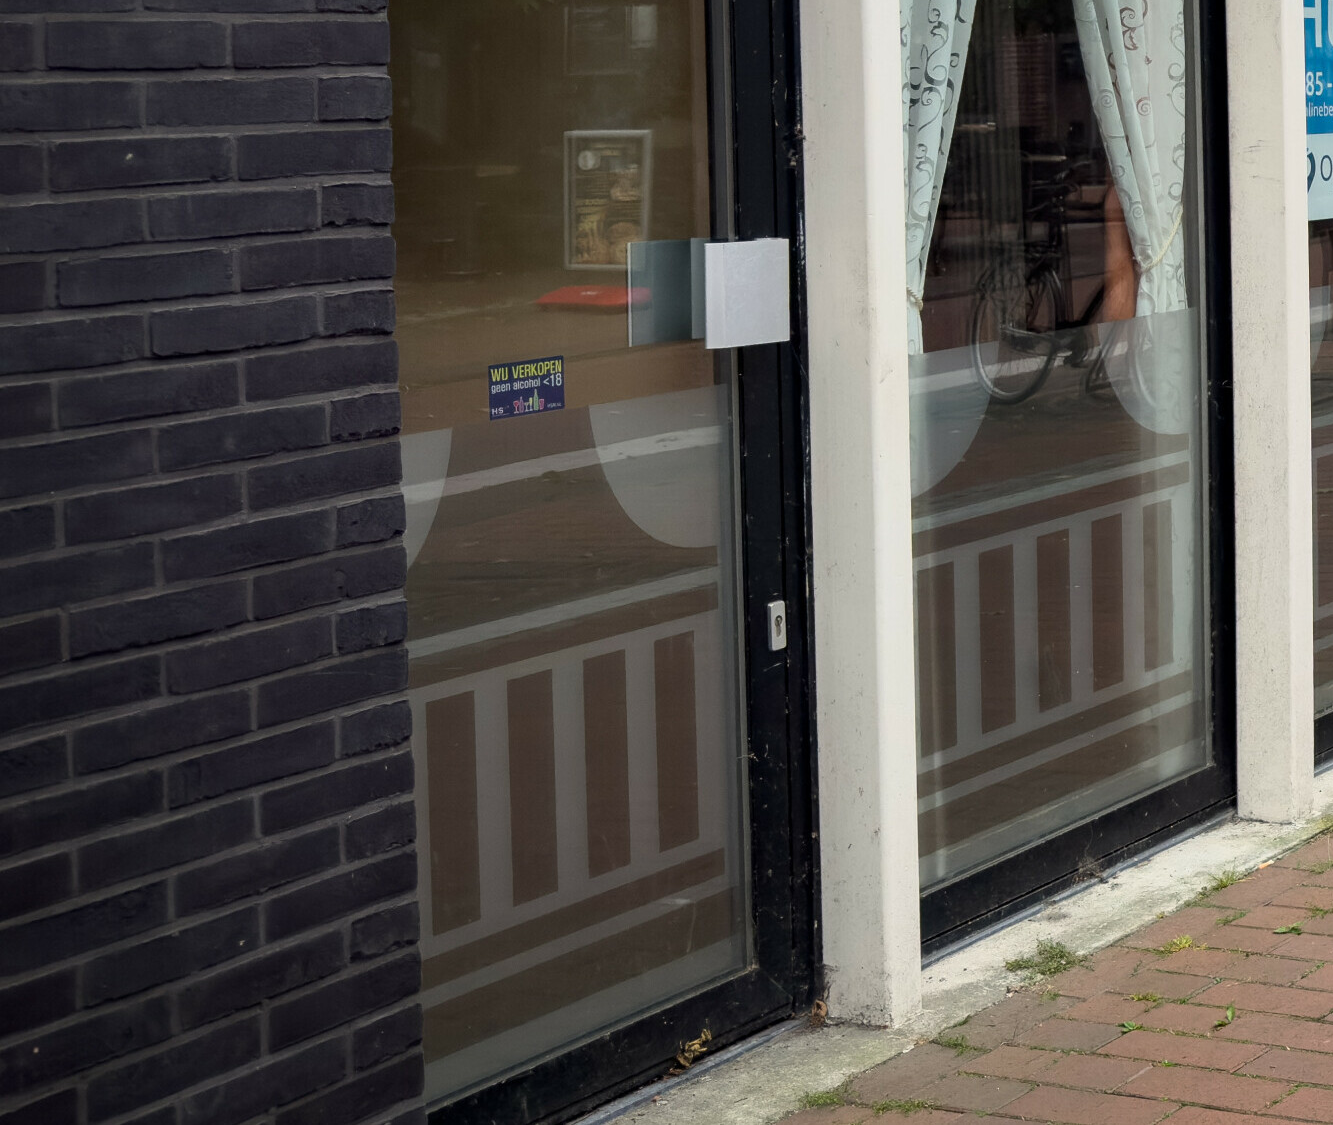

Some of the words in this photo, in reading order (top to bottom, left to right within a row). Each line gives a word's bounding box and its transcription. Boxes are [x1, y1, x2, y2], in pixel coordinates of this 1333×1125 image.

[1306, 71, 1323, 96] 85
[512, 359, 562, 379] VERKOPEN
[491, 382, 511, 394] geen
[513, 377, 541, 390] alcohol
[543, 373, 562, 387] <18
